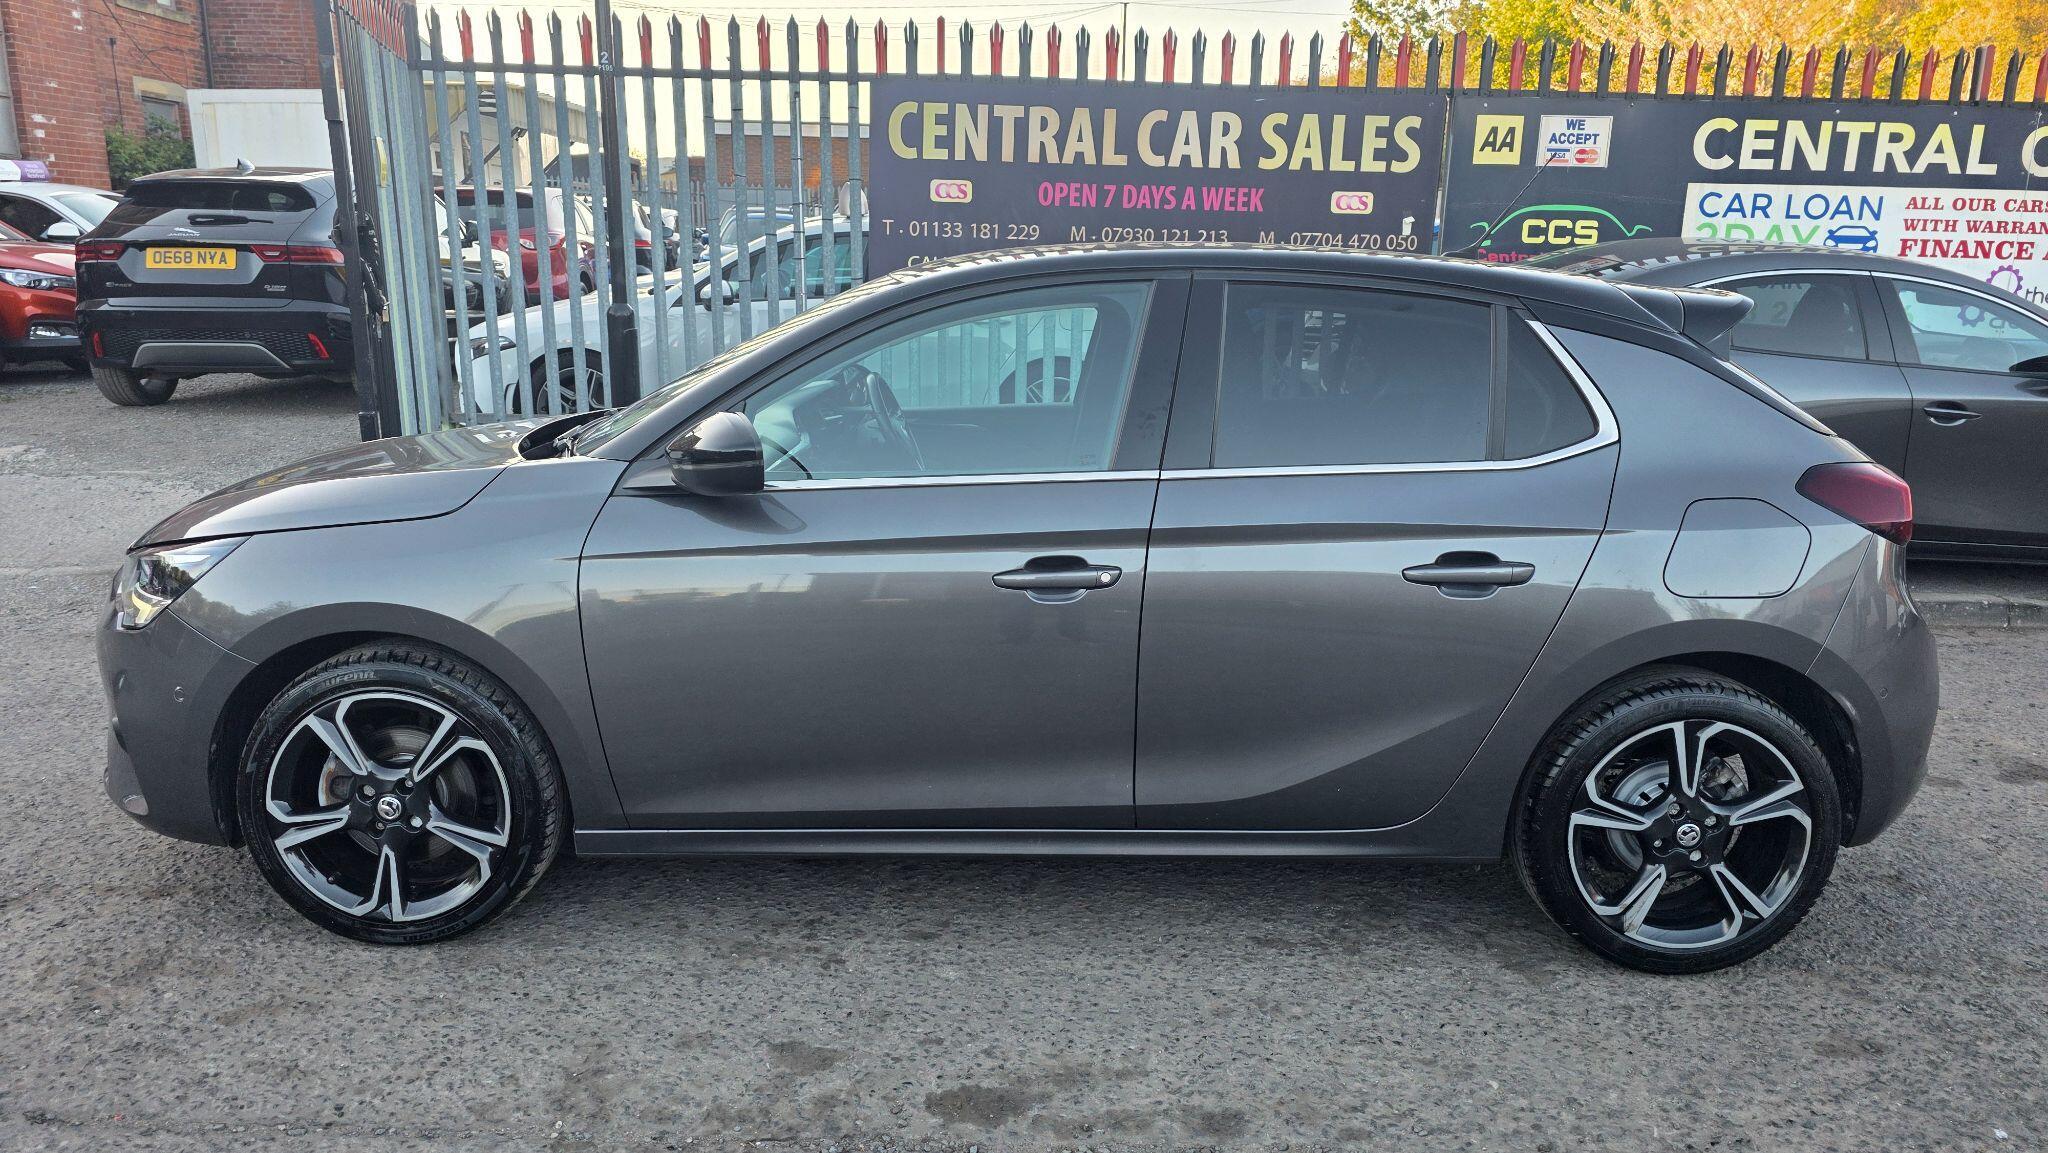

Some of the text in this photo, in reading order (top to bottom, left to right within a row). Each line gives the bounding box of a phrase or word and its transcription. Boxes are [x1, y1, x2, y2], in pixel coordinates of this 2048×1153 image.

[600, 51, 609, 63] 2
[1566, 118, 1586, 131] WE
[888, 101, 1422, 173] CENTRAL CAR SALES
[1479, 126, 1516, 152] AA
[1549, 133, 1600, 145] ACCEPT
[1693, 117, 1998, 176] CENTRAL
[934, 182, 968, 200] CCS
[1038, 182, 1265, 213] OPEN 7 DAYS A WEEK
[1335, 194, 1369, 211] CCS
[1698, 191, 1884, 221] CAR LOAN
[1905, 196, 1945, 210] ALL
[1952, 197, 1996, 212] OUR
[1521, 218, 1599, 245] CCS
[1903, 218, 1959, 233] WITH
[909, 220, 963, 238] 01133
[970, 223, 1000, 239] 181
[1006, 224, 1040, 240] 229
[1101, 227, 1154, 243] 07930
[1162, 228, 1189, 243] 121
[1198, 229, 1228, 243] 213
[1290, 232, 1344, 248] 07704
[1349, 233, 1380, 249] 470
[1386, 234, 1418, 250] 050
[153, 250, 228, 264] OE68 NYA
[1478, 248, 1543, 263] Centr
[1898, 238, 2036, 261] FINANCE
